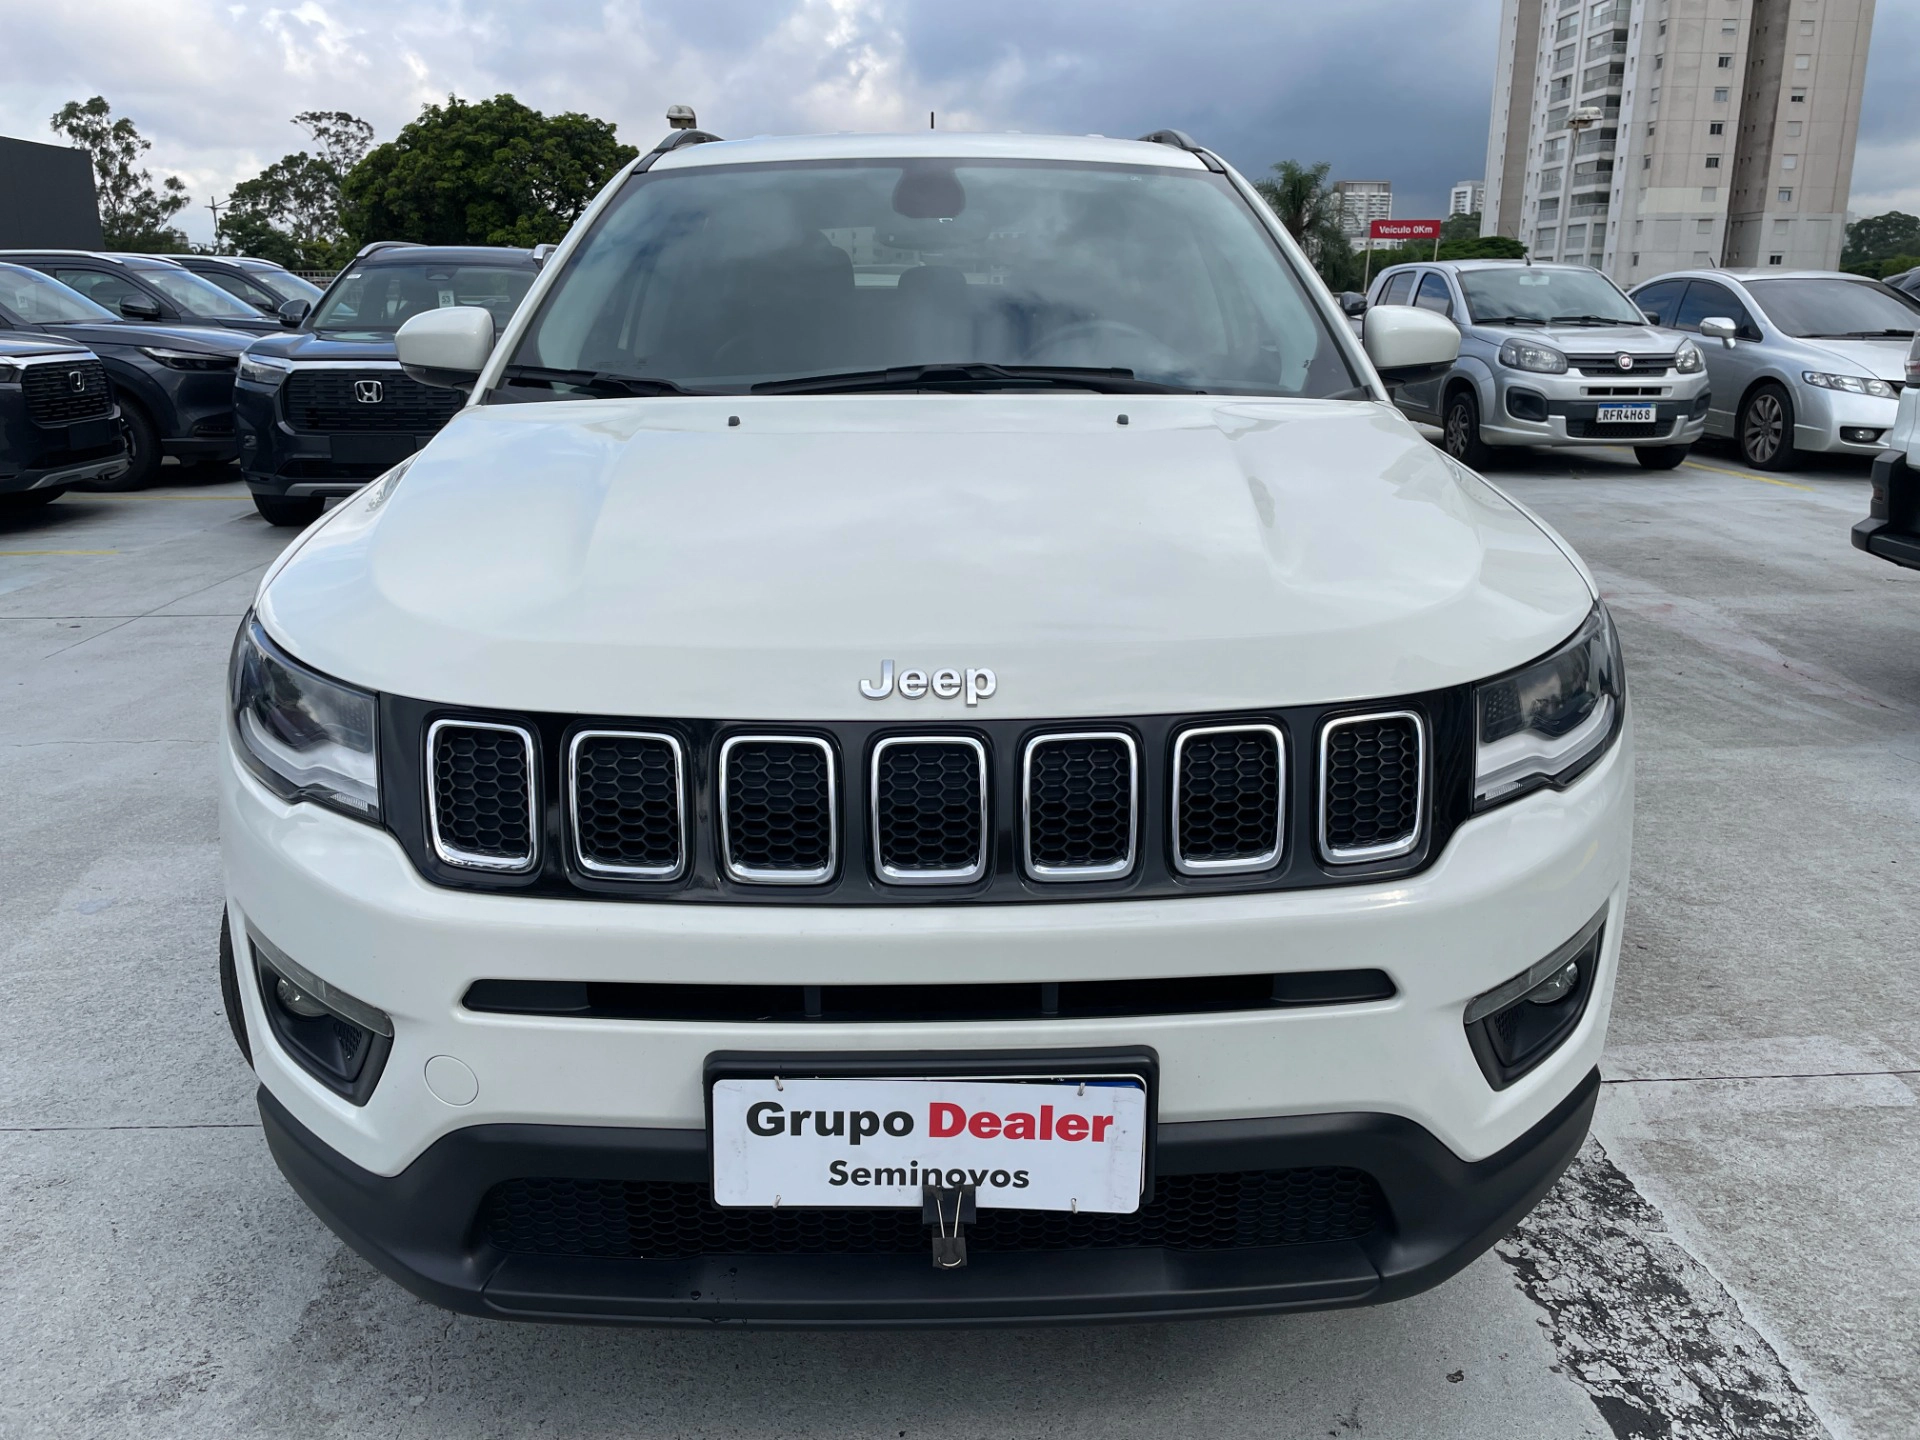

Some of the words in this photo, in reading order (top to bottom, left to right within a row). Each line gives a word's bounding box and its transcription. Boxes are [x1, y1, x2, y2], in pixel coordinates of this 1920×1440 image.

[1379, 225, 1411, 234] Veículo
[1413, 225, 1433, 234] 0Km
[1602, 409, 1651, 421] RFR4H68
[859, 659, 997, 708] Jeep
[745, 1101, 914, 1145] Grupo
[928, 1102, 1114, 1142] Dealer
[828, 1160, 1030, 1189] Seminovos
